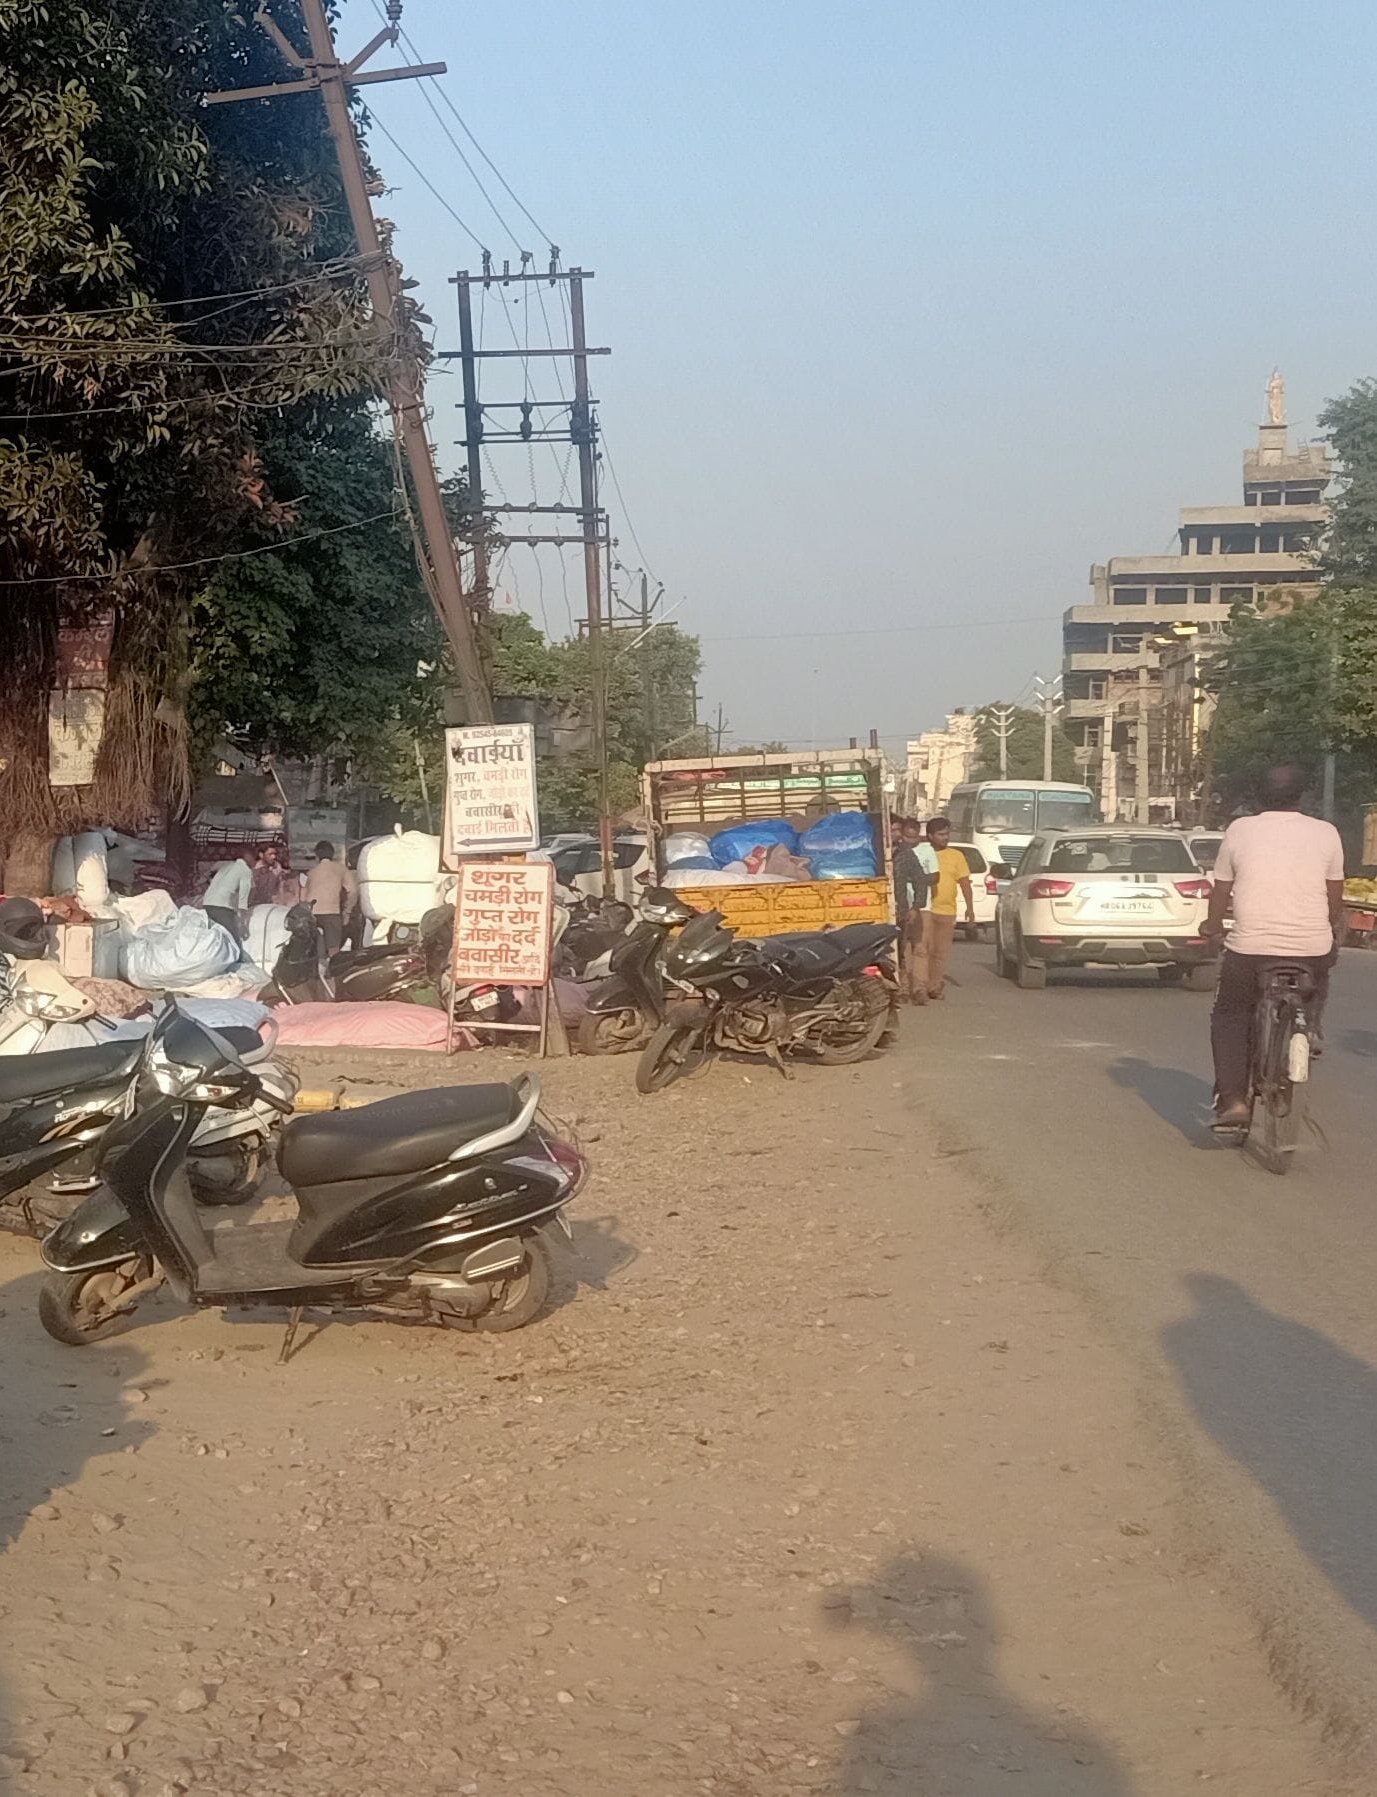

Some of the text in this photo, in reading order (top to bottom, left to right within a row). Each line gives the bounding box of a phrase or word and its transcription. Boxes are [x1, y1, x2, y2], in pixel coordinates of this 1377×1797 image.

[463, 885, 544, 907] चमड़ी रोग
[462, 906, 541, 925] गुप्त रोग
[512, 926, 541, 946] दर्द
